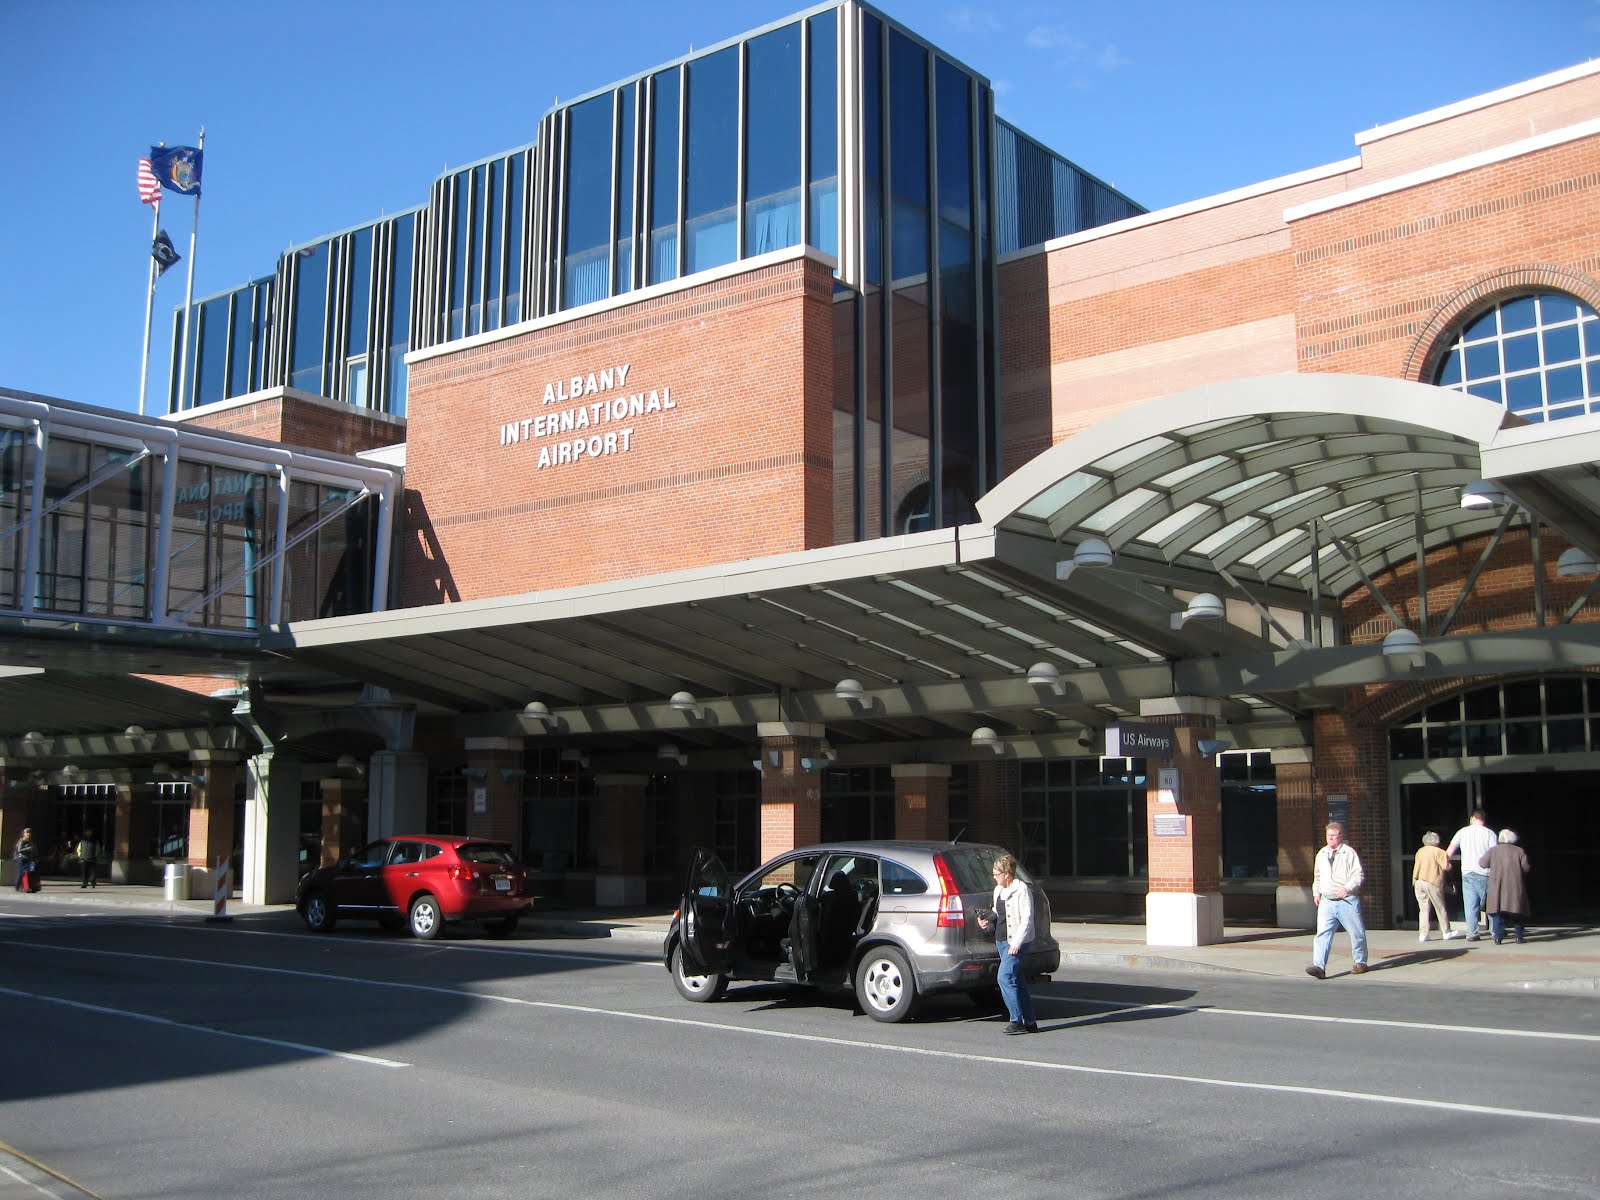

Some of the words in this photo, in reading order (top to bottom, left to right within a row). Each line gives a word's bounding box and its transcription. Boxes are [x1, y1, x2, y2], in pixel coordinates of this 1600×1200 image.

[542, 364, 631, 405] ALBANY
[500, 387, 677, 445] INTERNATIONAL
[537, 428, 634, 469] AIRPORT
[1123, 733, 1136, 746] US
[1137, 734, 1170, 750] Airways
